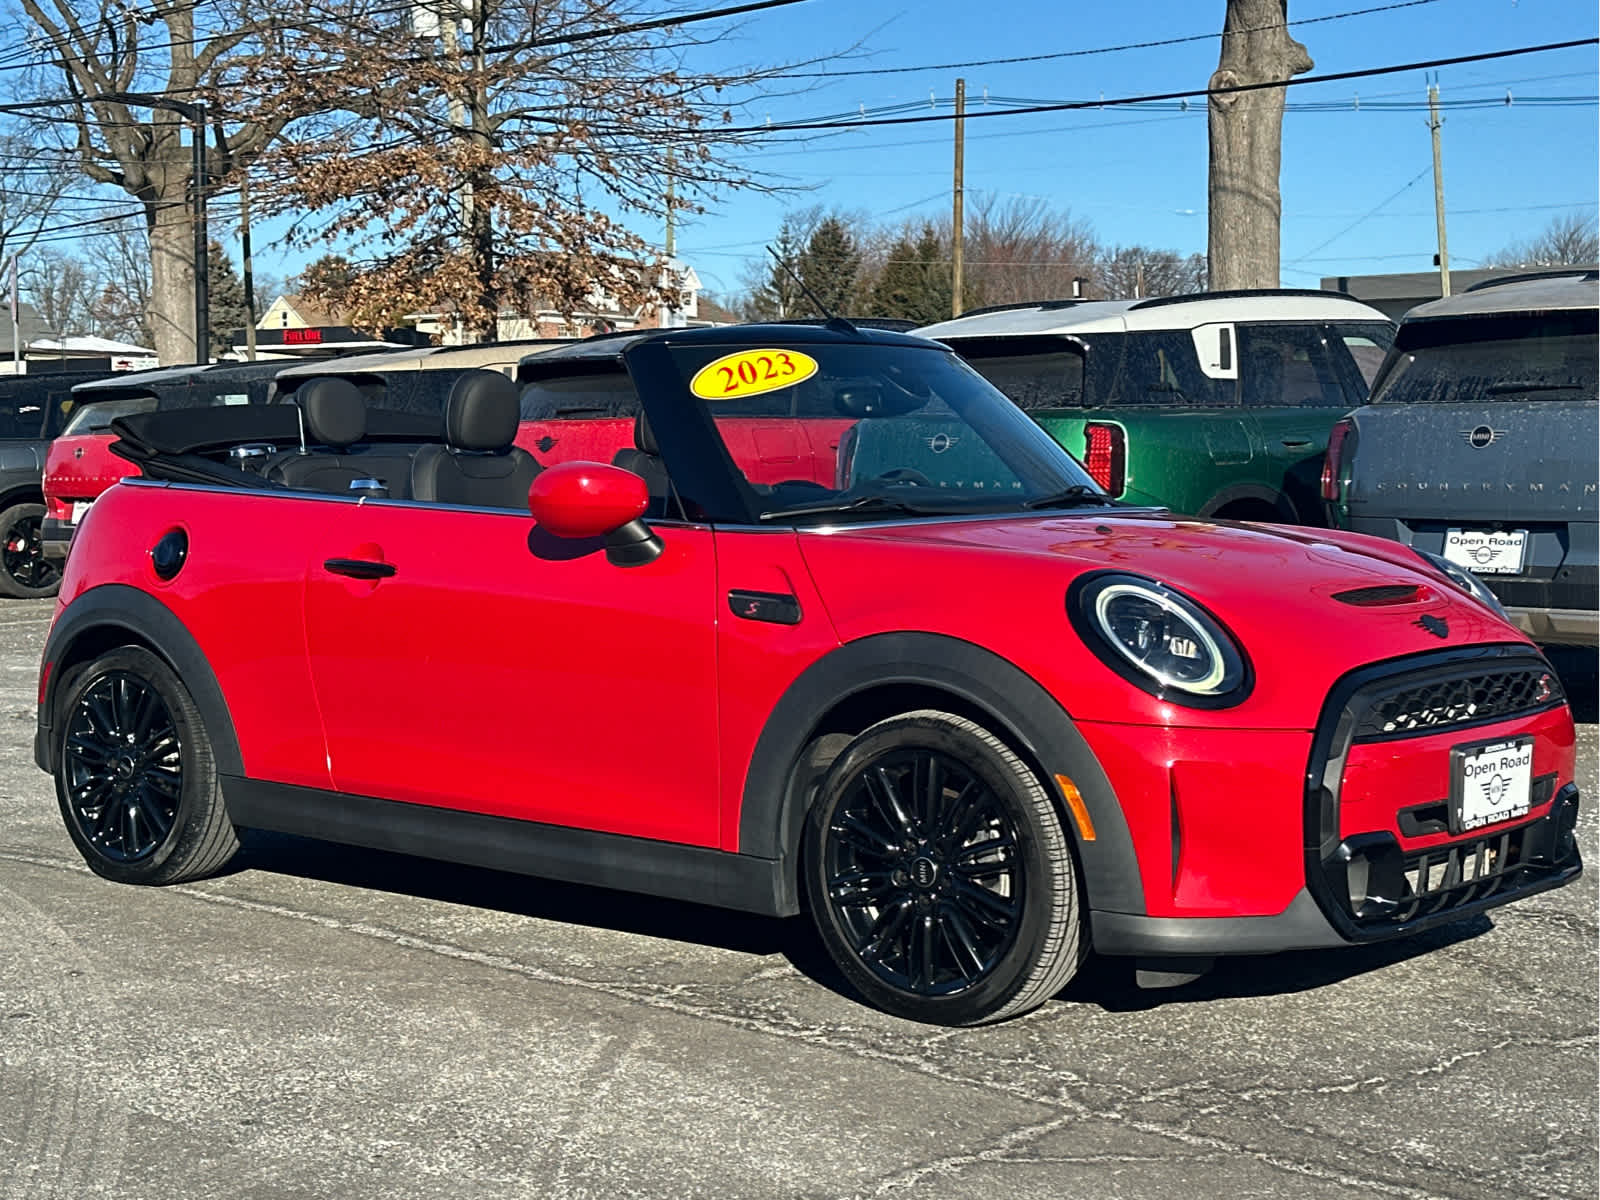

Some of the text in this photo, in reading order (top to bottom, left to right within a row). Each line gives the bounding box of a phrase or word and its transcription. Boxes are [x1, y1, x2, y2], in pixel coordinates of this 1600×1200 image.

[717, 353, 796, 393] 2023
[1472, 433, 1490, 441] MINI
[1450, 536, 1522, 546] Open Road
[744, 601, 760, 615] S
[1535, 673, 1551, 702] S
[1464, 752, 1530, 779] Open Road
[1487, 810, 1510, 824] ROAD
[919, 861, 928, 884] MINI
